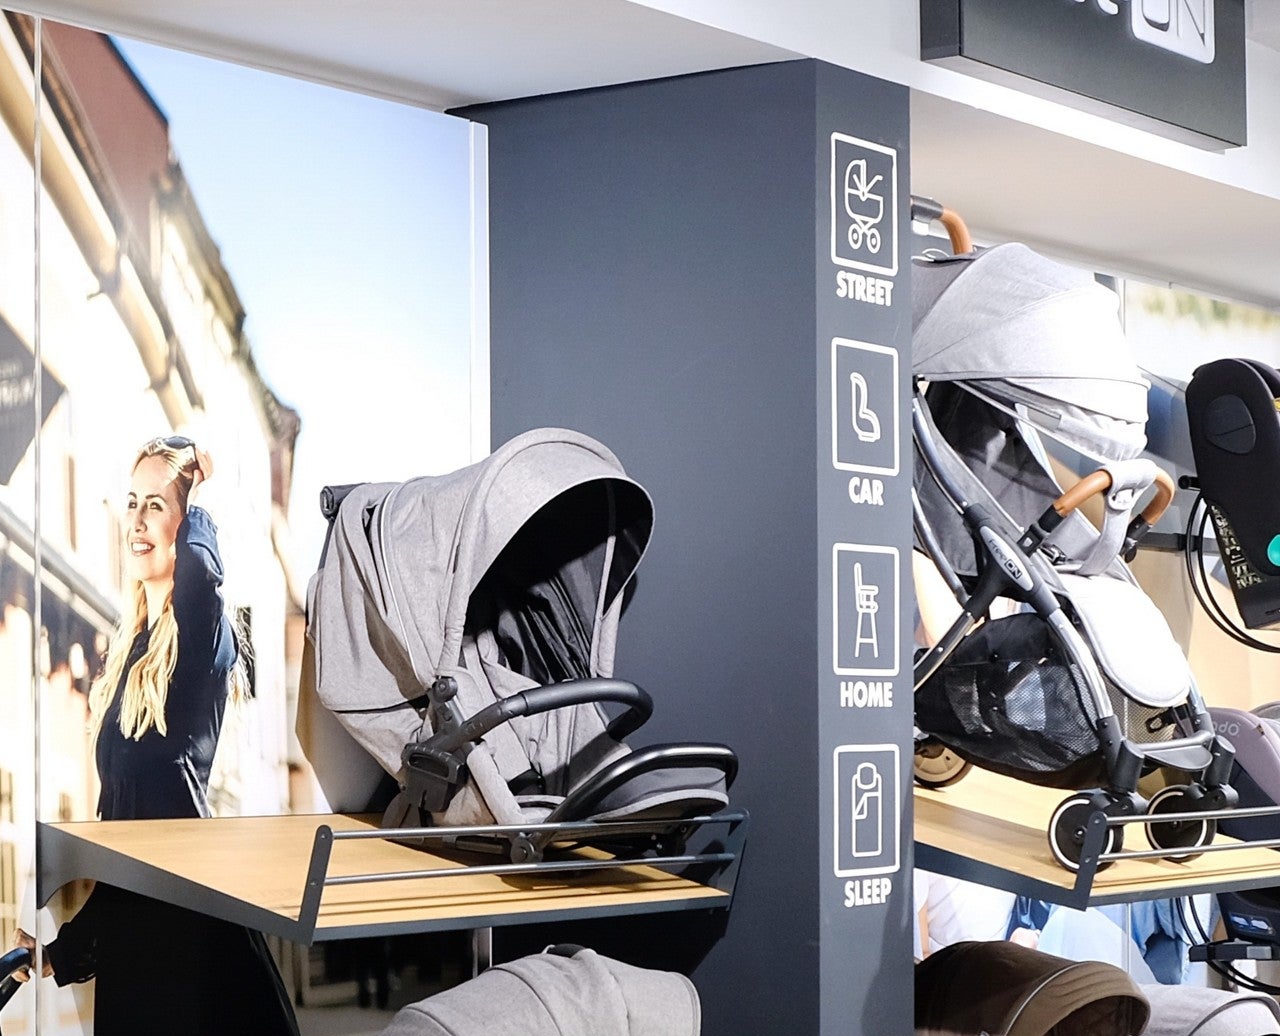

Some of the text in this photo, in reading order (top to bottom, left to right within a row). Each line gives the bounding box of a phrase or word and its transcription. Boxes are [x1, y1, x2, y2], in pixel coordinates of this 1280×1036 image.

[836, 270, 894, 307] STREET
[848, 476, 884, 506] CAR
[840, 681, 893, 708] HOME
[844, 877, 892, 908] SLEEP
